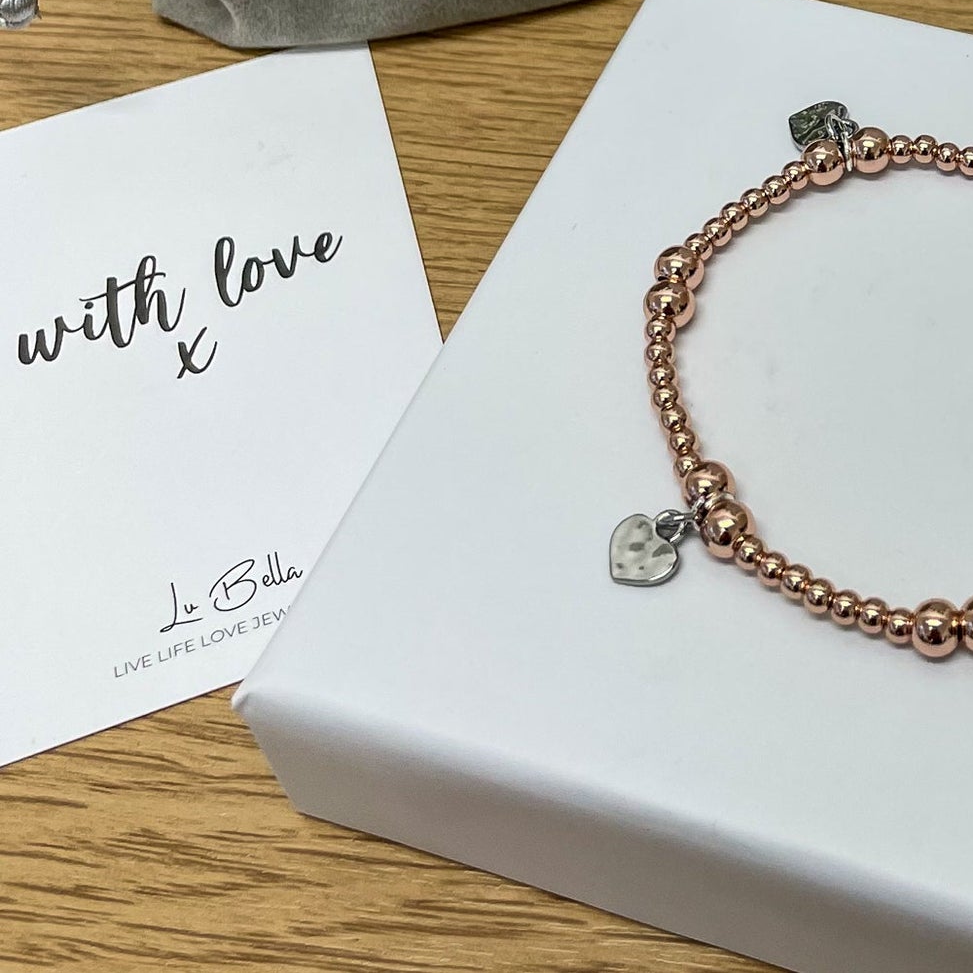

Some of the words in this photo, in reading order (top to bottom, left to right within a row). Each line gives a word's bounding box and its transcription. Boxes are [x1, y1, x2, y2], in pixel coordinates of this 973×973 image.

[17, 255, 186, 365] with
[214, 231, 343, 307] love
[176, 326, 218, 379] x
[159, 582, 204, 634] Lu
[209, 551, 304, 612] Bella
[113, 653, 153, 679] LIVE
[157, 638, 196, 664] LIFE
[201, 620, 248, 648] LOVE
